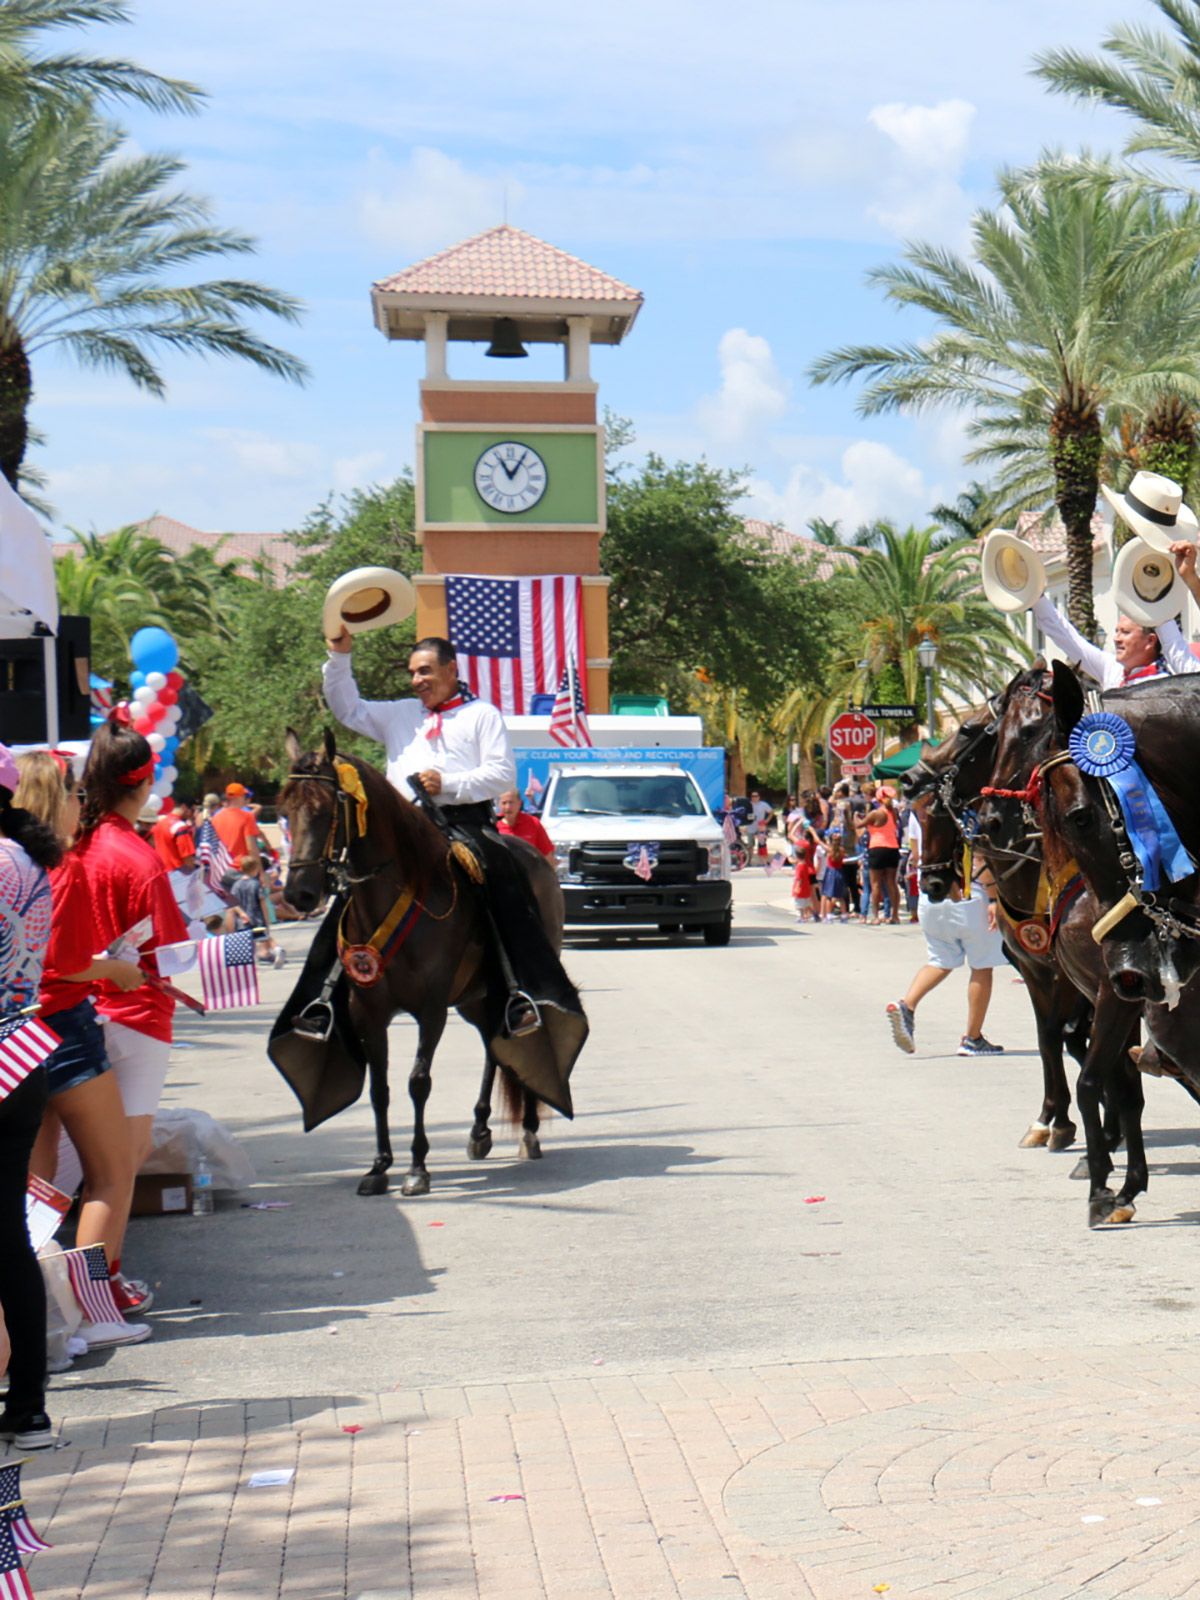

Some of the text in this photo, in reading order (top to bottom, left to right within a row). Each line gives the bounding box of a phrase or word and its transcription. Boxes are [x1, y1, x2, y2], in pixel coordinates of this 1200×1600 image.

[881, 708, 903, 717] TOWER
[832, 727, 874, 746] STOP
[530, 751, 560, 760] CLEAN
[563, 751, 589, 760] YOUR
[623, 751, 643, 760] AND
[645, 751, 695, 760] RECYCLING
